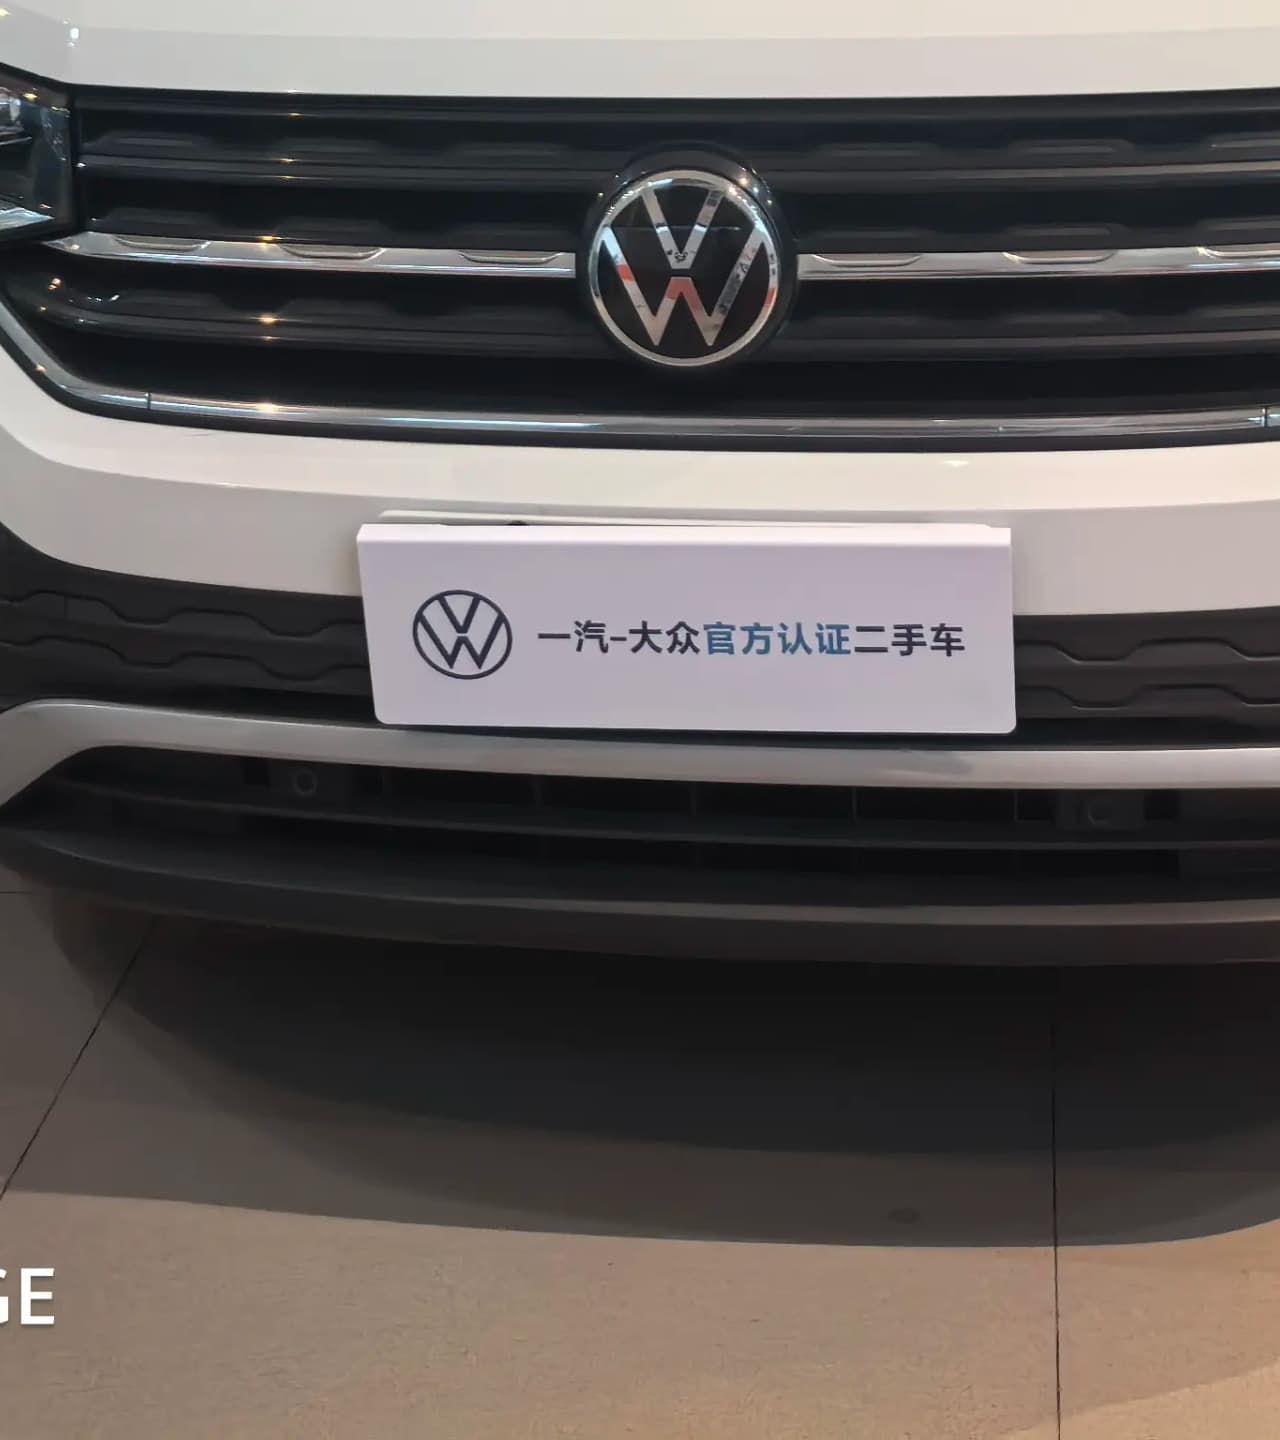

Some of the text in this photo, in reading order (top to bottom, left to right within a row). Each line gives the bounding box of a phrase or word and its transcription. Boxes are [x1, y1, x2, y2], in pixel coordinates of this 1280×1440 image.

[537, 620, 966, 658] 一汽-大众官方认证二手车
